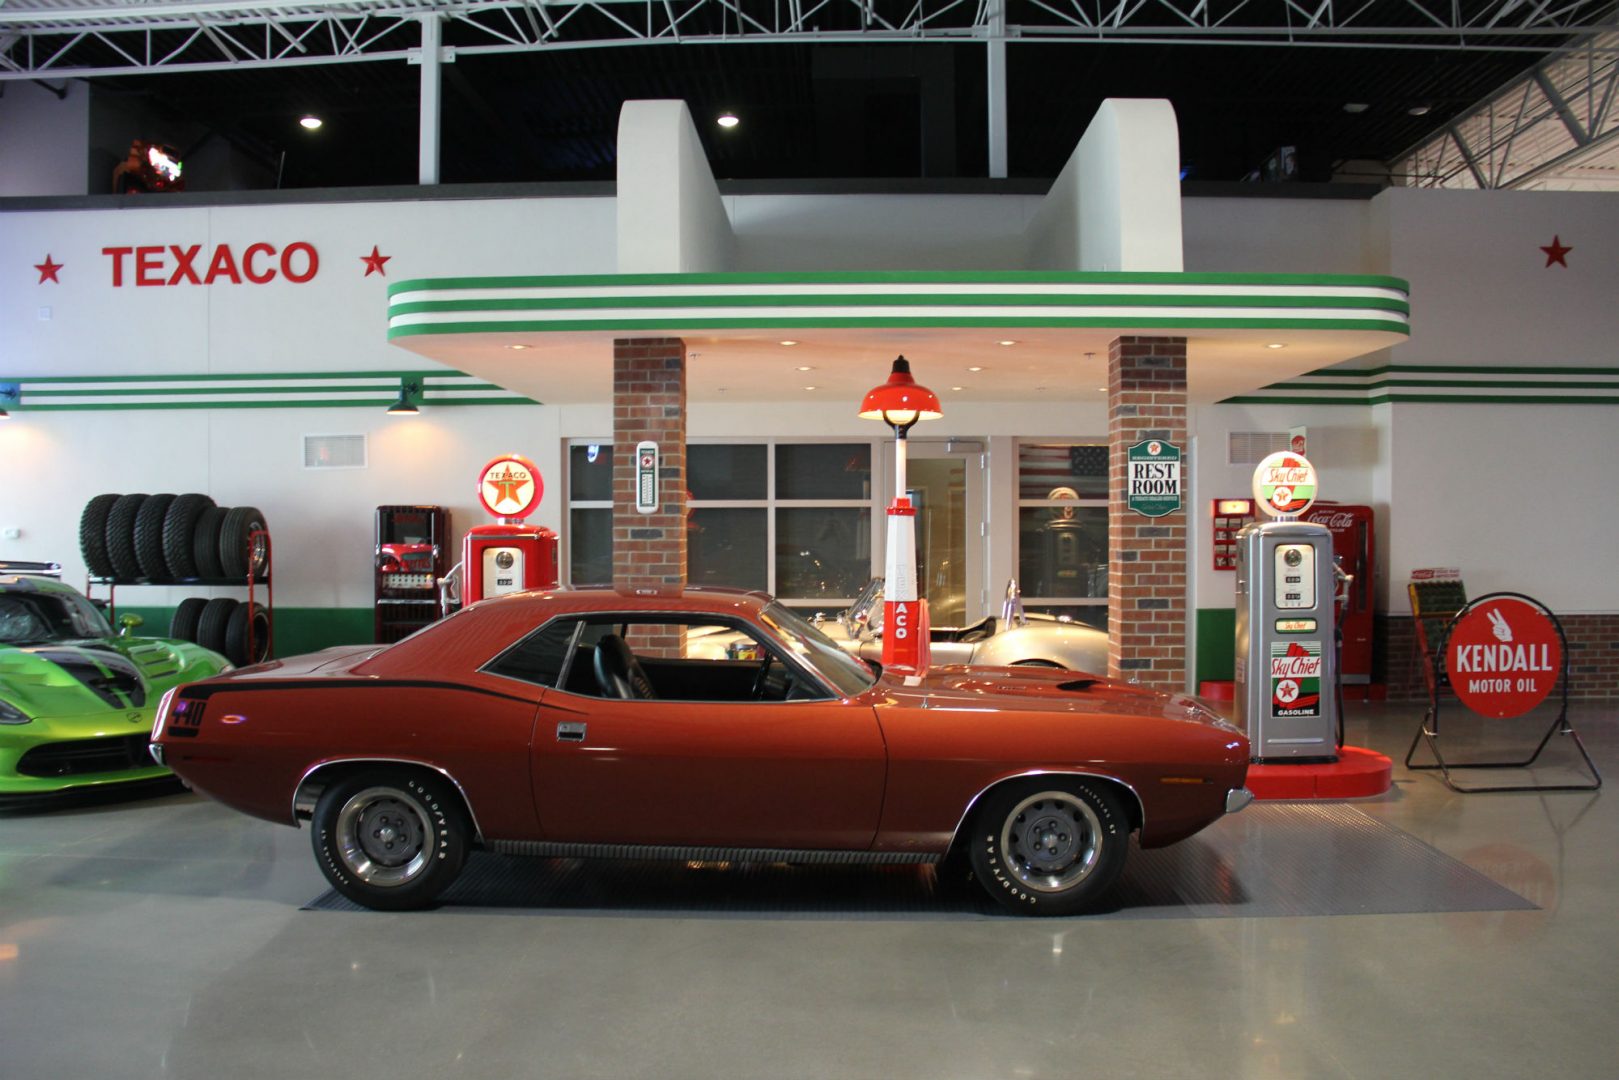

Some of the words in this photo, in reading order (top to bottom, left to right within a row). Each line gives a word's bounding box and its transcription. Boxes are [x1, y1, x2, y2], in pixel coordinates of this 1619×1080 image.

[102, 241, 320, 287] TEXACO
[1134, 463, 1175, 479] REST
[1268, 468, 1285, 483] Sky
[1286, 467, 1309, 483] Chief
[1132, 480, 1178, 495] ROOM
[1271, 658, 1291, 678] Sky
[1291, 657, 1321, 675] Chief
[1456, 644, 1553, 673] KENDALL
[1469, 679, 1511, 693] MOTOR
[1516, 678, 1537, 692] OIL
[172, 700, 207, 726] 440
[408, 780, 449, 860] GOODYEAR
[986, 835, 1036, 904] GOODYEAR
